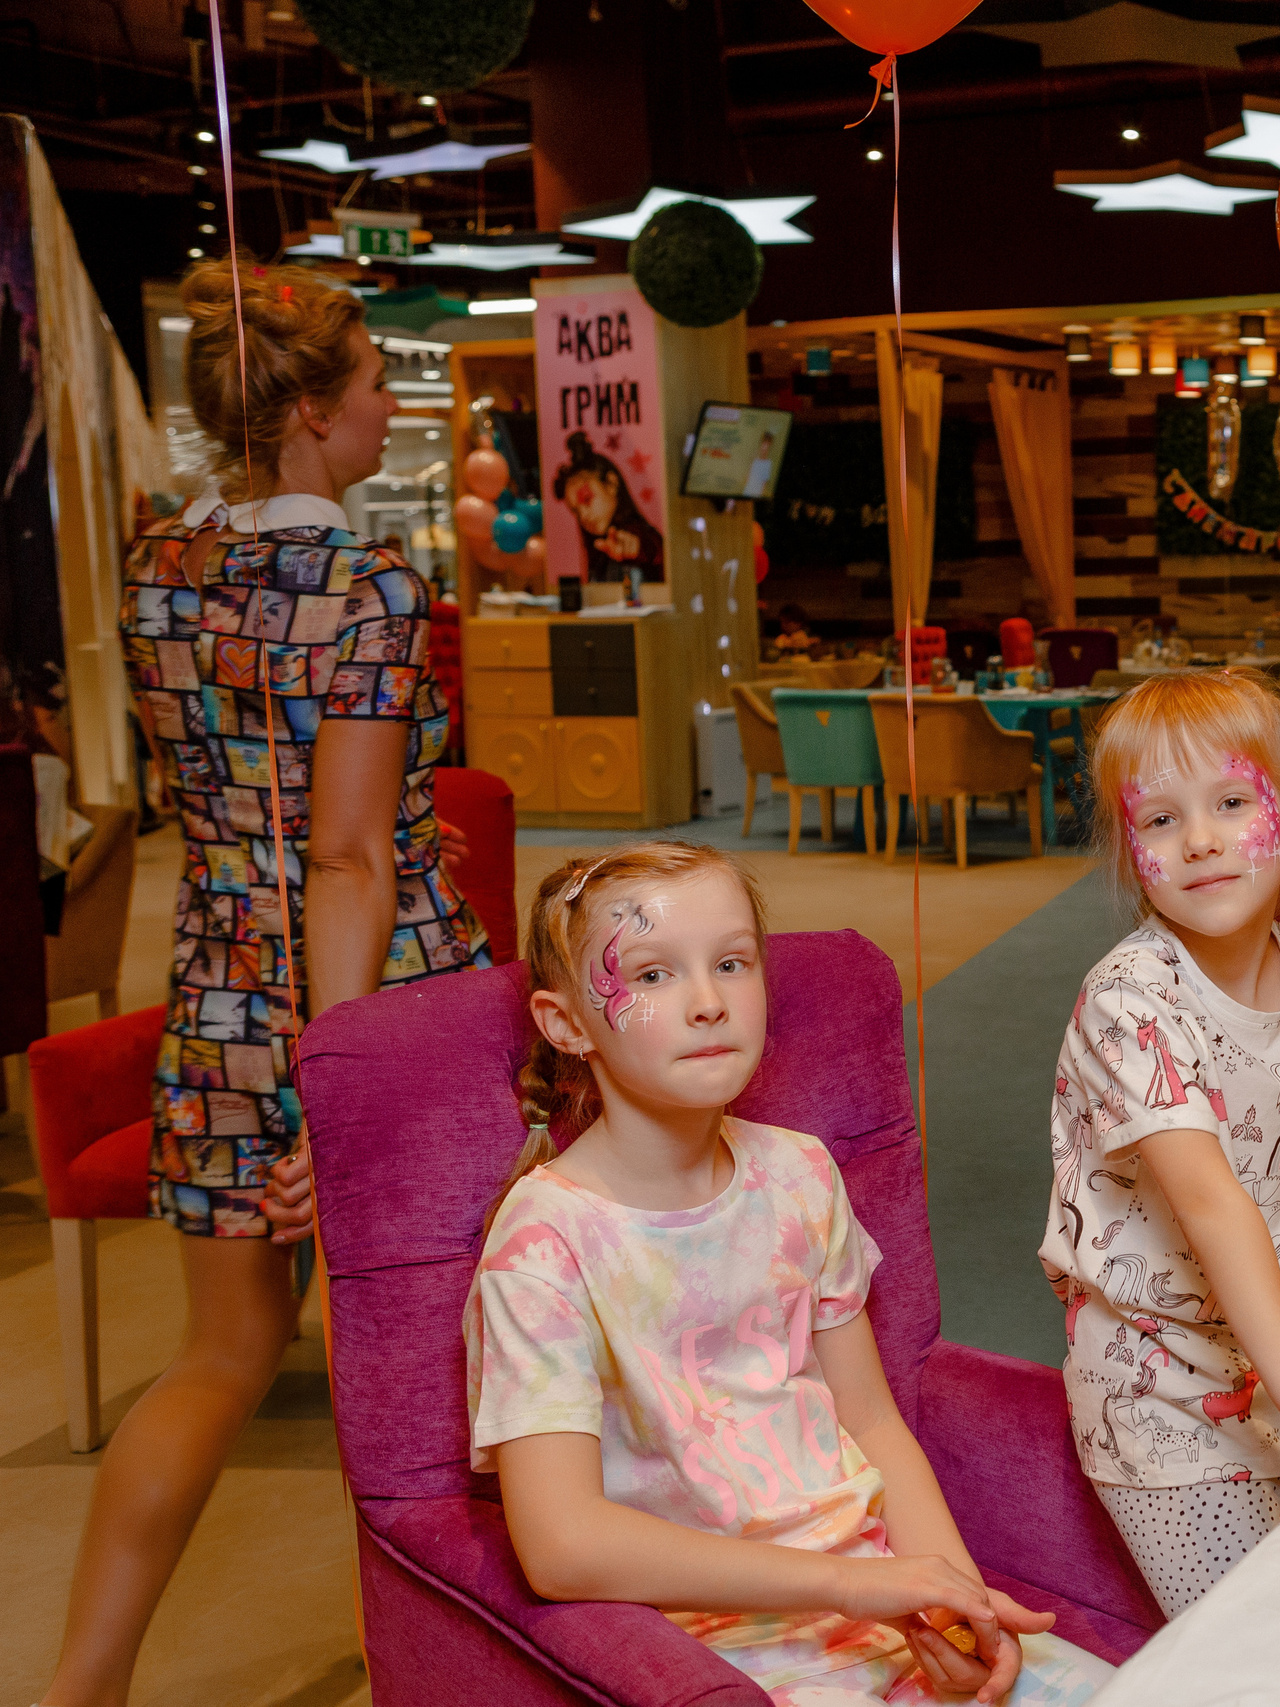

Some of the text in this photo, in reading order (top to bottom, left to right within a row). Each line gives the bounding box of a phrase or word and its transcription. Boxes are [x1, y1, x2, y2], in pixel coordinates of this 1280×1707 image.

[556, 308, 633, 363] АКВА
[559, 380, 641, 429] ГРИМ
[634, 1285, 812, 1432] BEST
